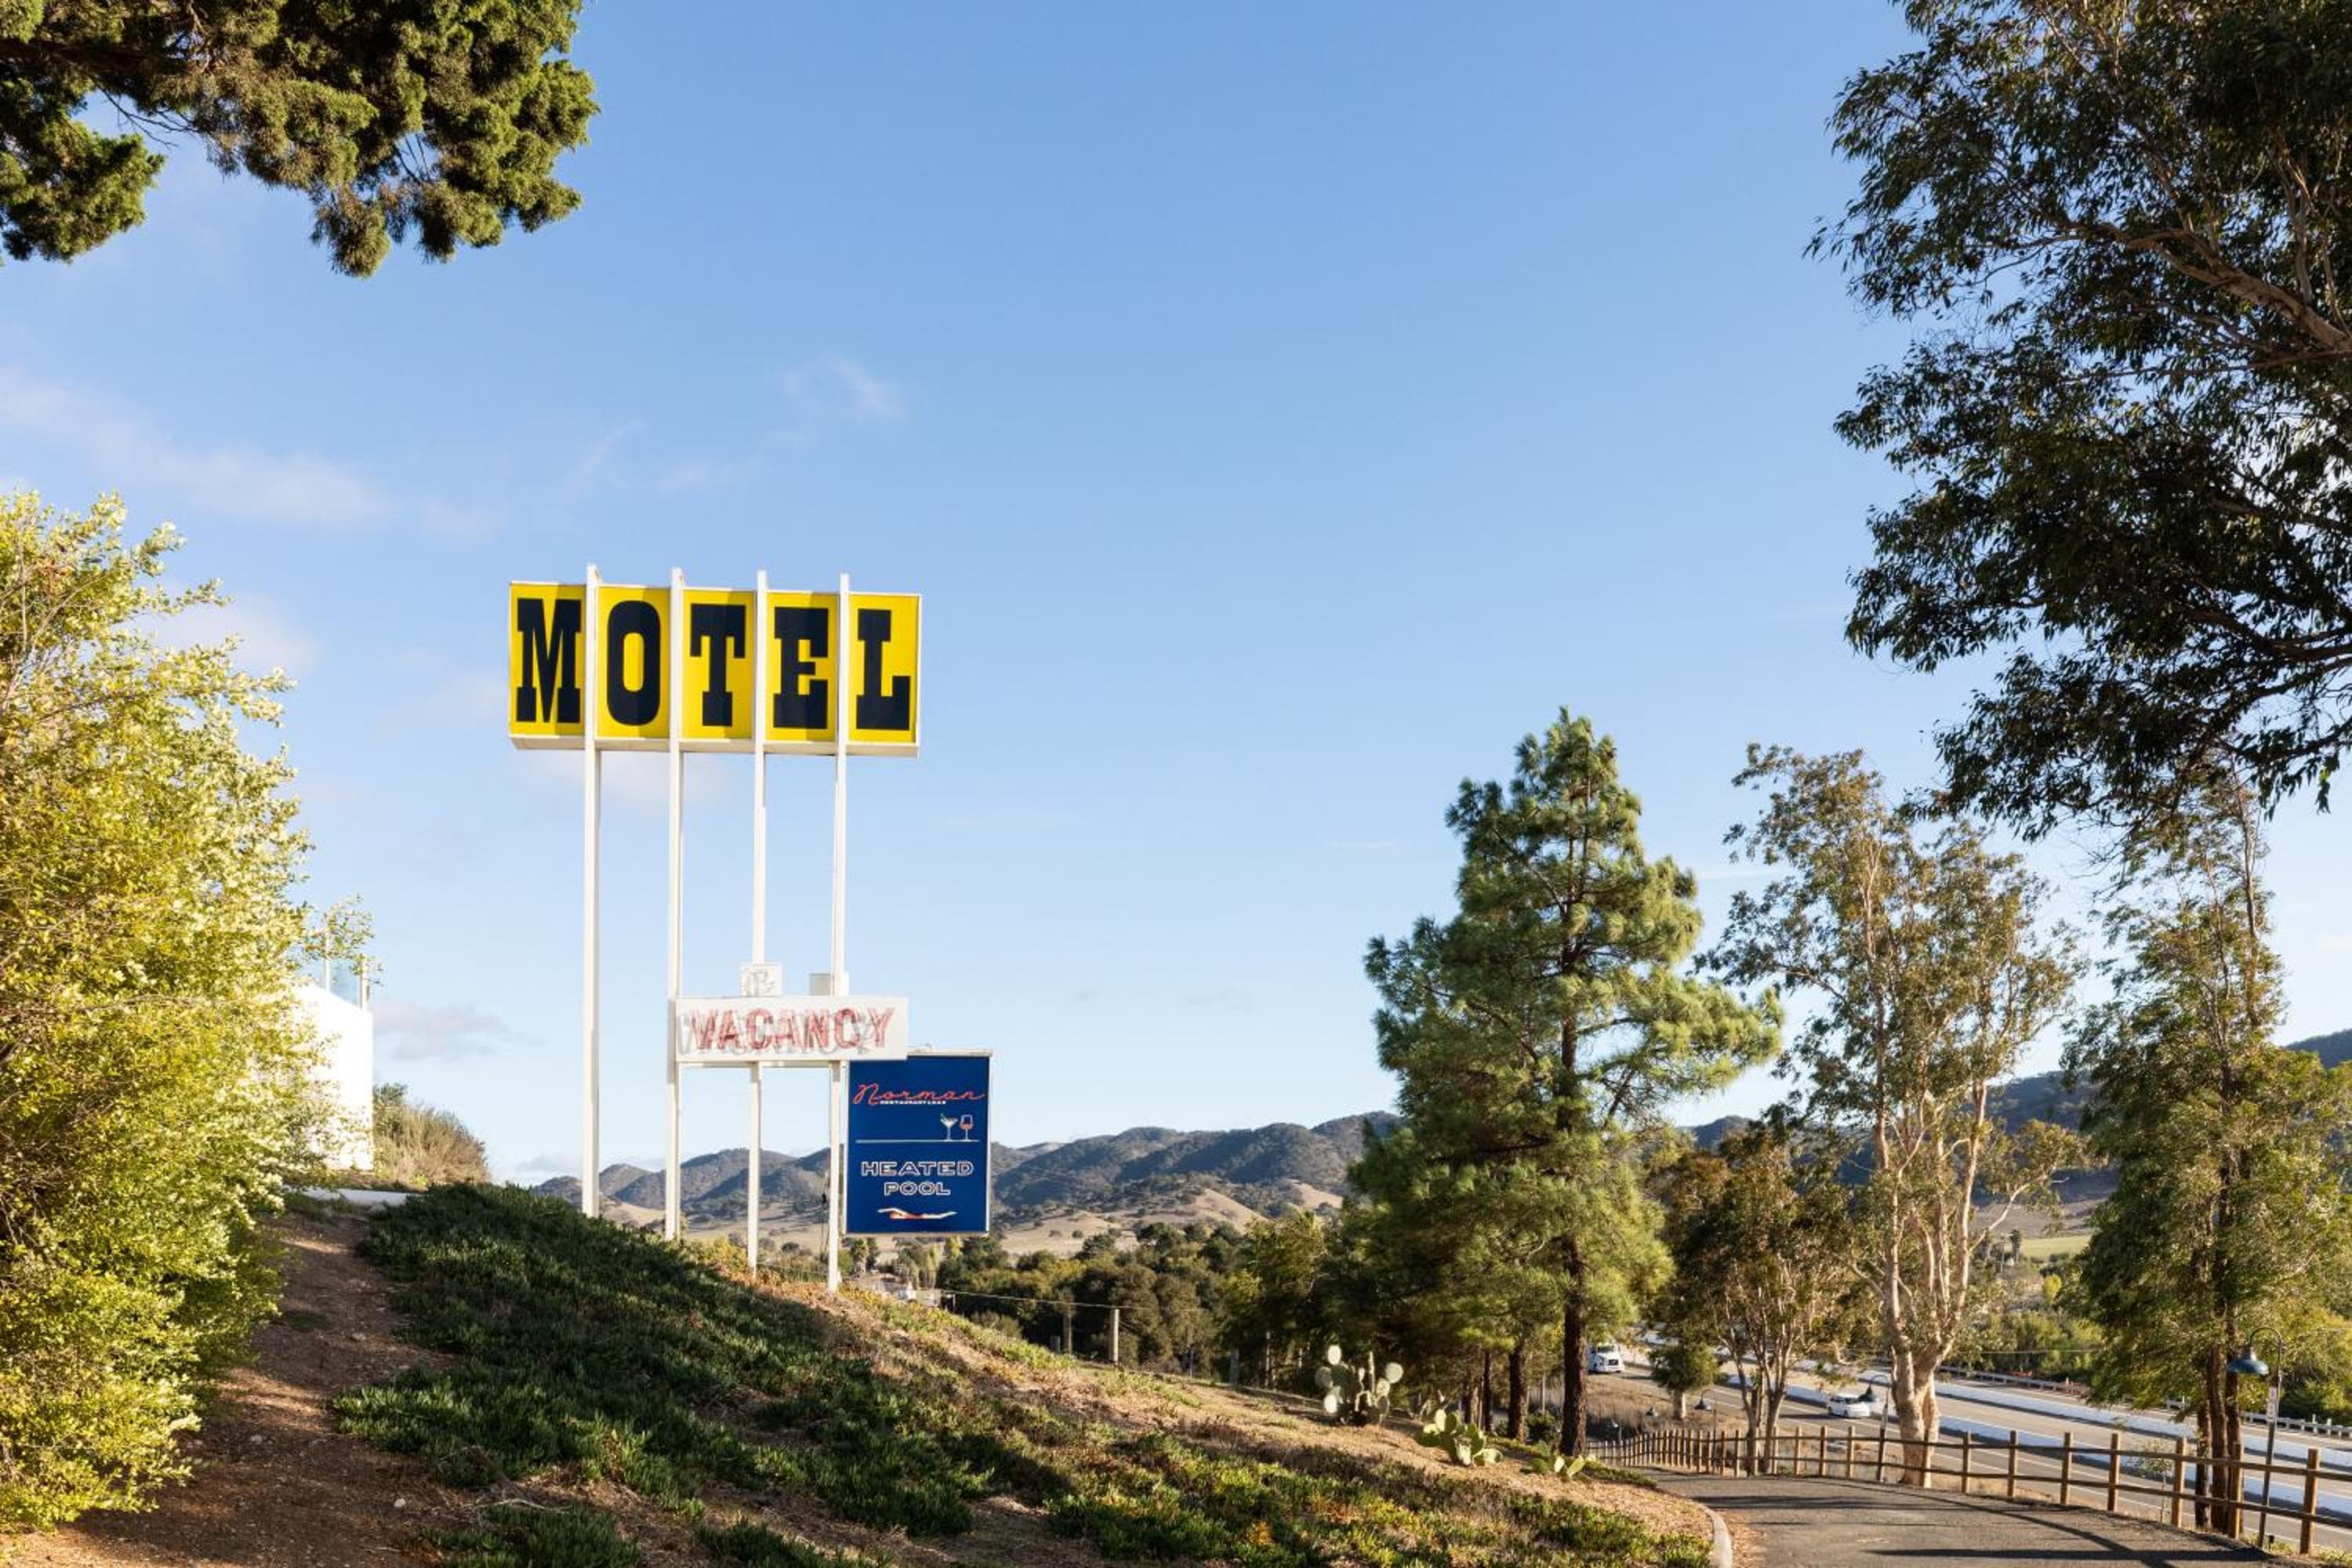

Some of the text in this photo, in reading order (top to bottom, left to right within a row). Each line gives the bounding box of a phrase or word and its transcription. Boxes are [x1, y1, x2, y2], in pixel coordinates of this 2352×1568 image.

[516, 597, 911, 731] MOTEL
[691, 1007, 896, 1050] VACANCY
[852, 1083, 985, 1105] Norman
[861, 1160, 975, 1177] HEATED
[884, 1181, 951, 1196] POOL
